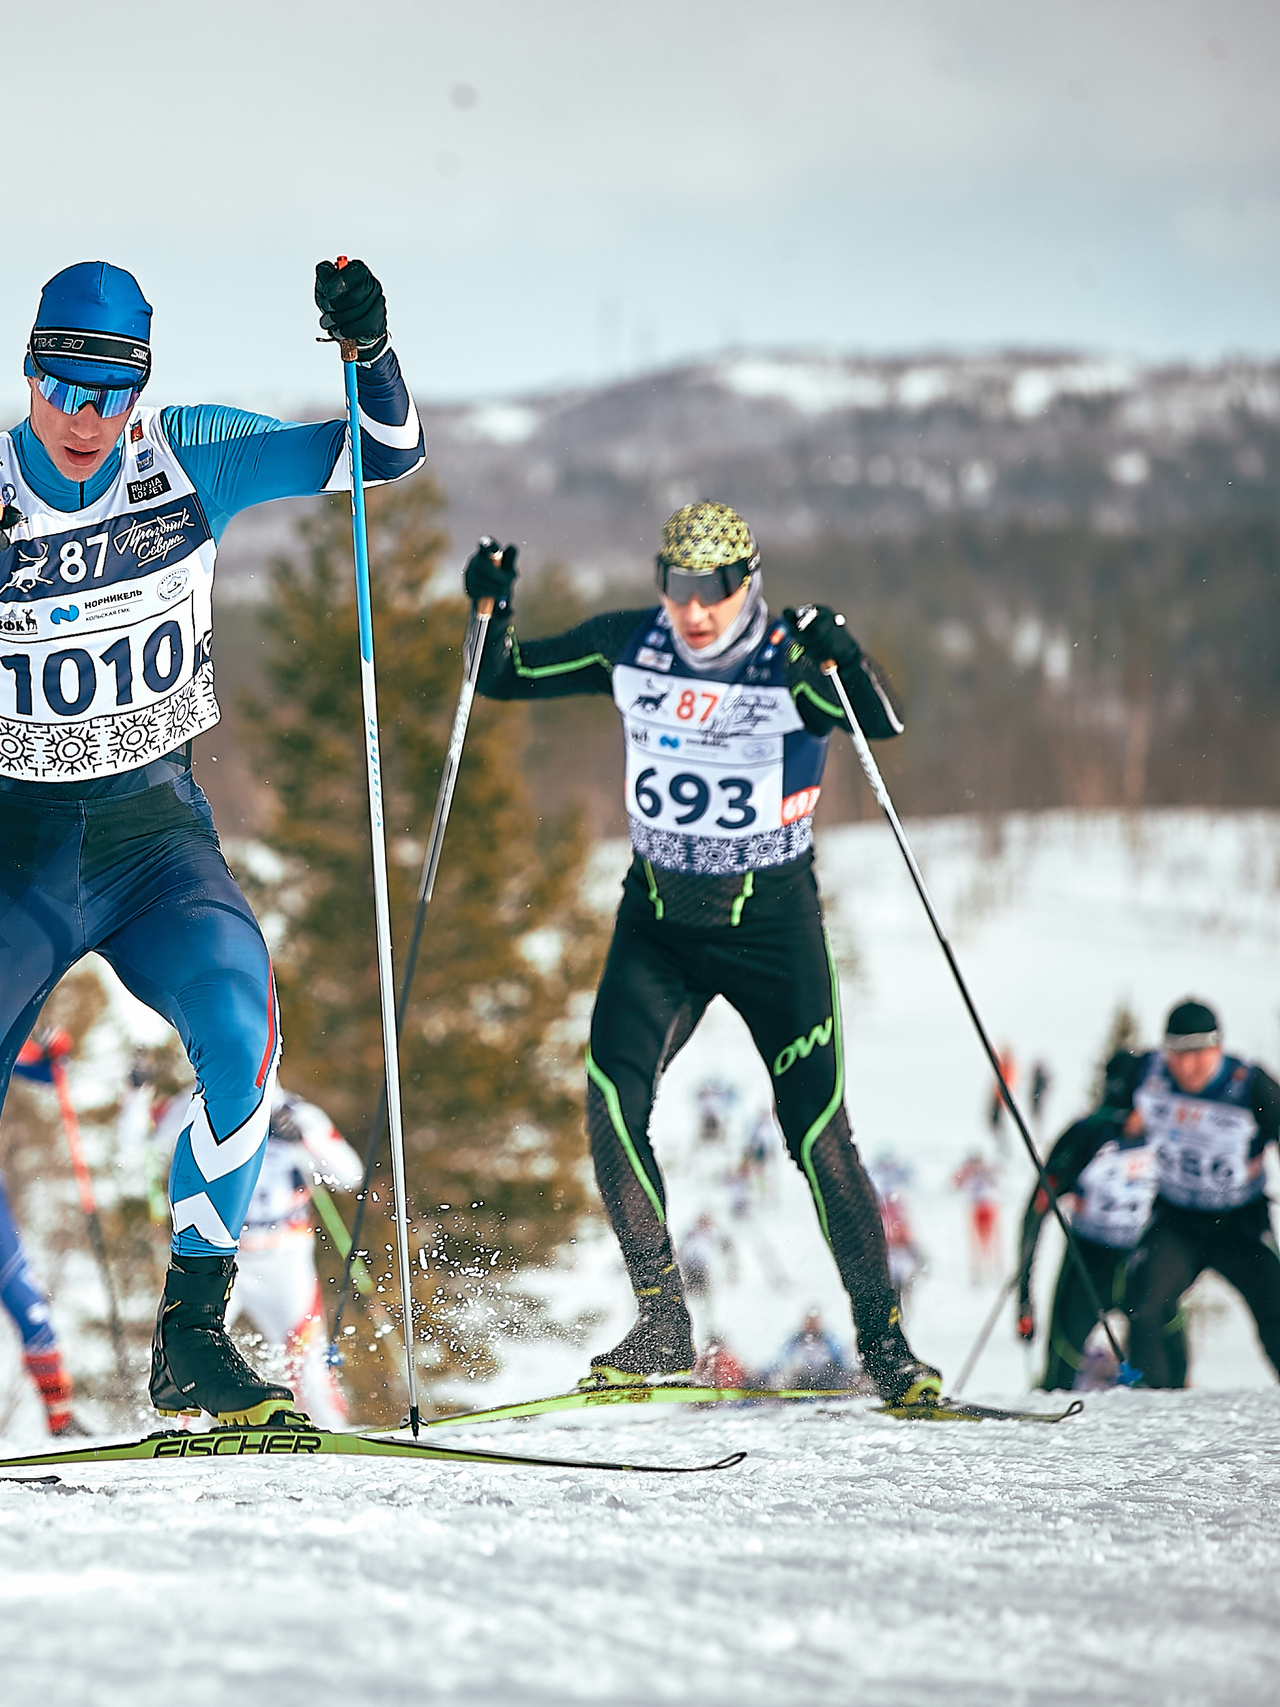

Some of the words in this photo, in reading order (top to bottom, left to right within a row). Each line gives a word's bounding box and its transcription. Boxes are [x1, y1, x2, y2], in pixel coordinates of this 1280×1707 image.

[60, 338, 85, 350] 30
[59, 532, 110, 584] 87
[84, 589, 143, 609] НОРНИКЕЛЬ
[0, 620, 184, 717] 1010
[676, 689, 719, 724] 87
[634, 767, 758, 830] 693
[152, 1433, 322, 1459] FISCHER
